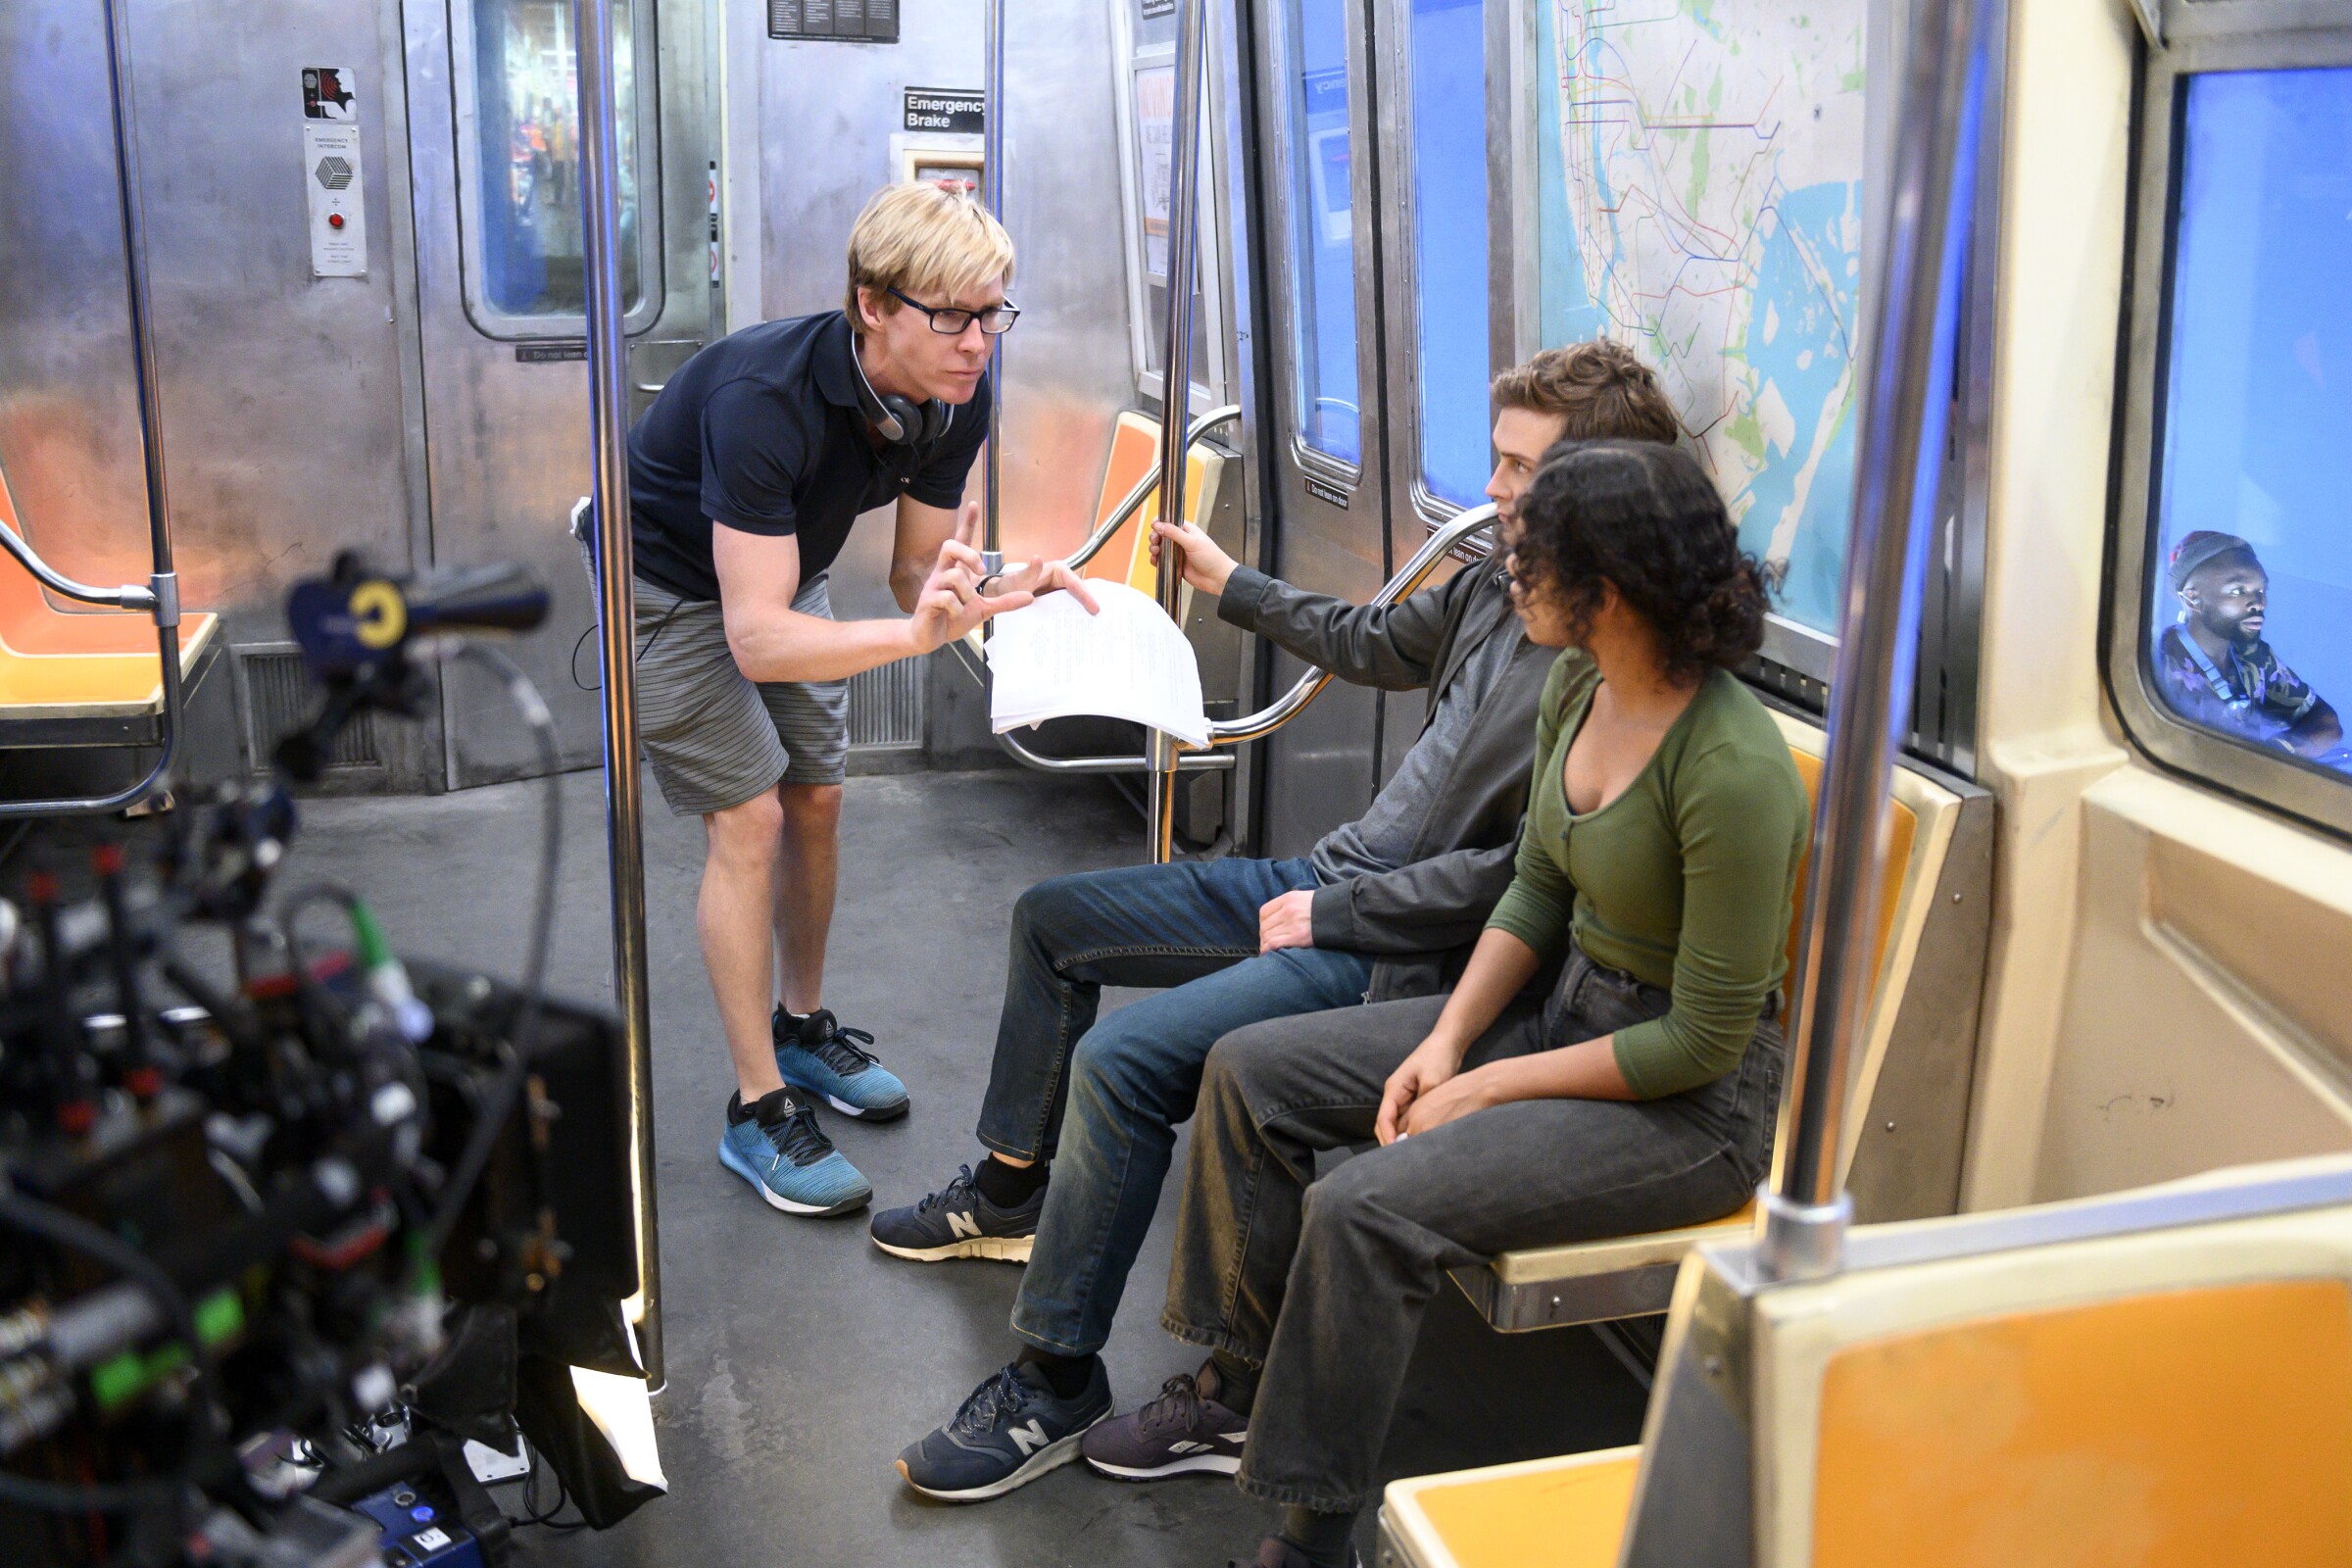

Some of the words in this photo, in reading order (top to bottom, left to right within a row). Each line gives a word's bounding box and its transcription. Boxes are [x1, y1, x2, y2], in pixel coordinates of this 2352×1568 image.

[907, 113, 950, 127] Brake
[533, 351, 546, 360] Do
[1311, 484, 1318, 494] Do
[1452, 546, 1464, 561] lean
[1465, 553, 1473, 564] on
[947, 1211, 982, 1238] N
[1008, 1418, 1050, 1455] N
